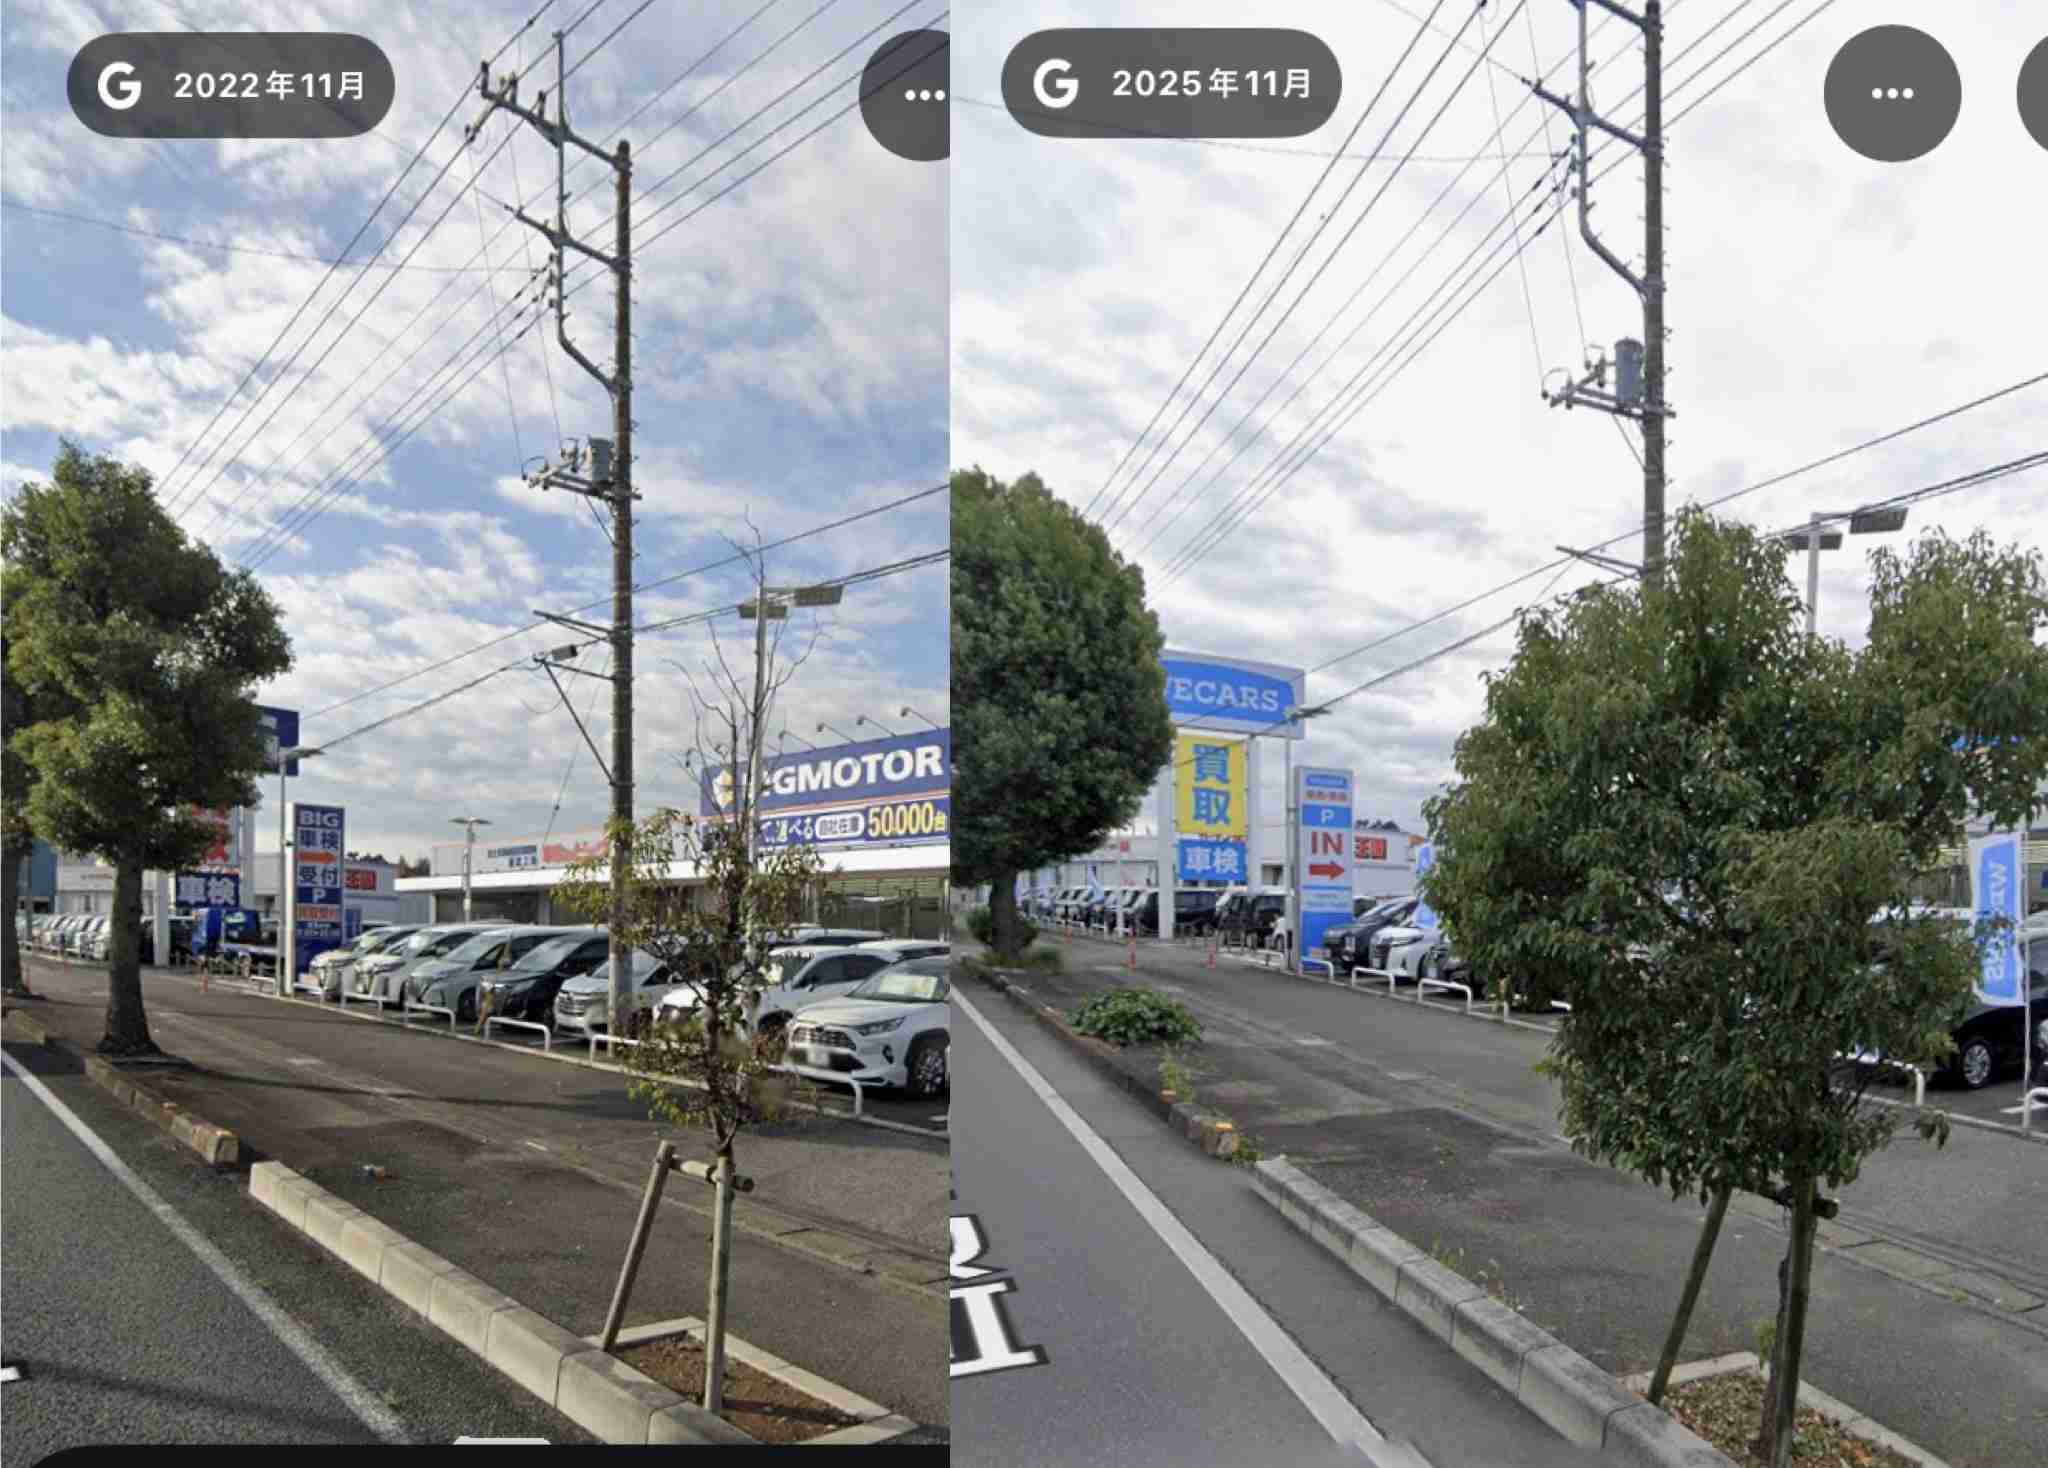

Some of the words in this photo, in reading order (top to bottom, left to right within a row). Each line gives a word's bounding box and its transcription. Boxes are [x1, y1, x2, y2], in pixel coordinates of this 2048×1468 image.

[1163, 676, 1279, 712] ECARS
[1192, 744, 1231, 826] 買取
[300, 810, 339, 827] BIG
[1321, 808, 1335, 825] P
[1311, 831, 1344, 856] IN
[1184, 847, 1239, 874] 車検
[299, 864, 340, 887] 受付
[178, 875, 235, 905] 車検
[312, 888, 326, 903] P
